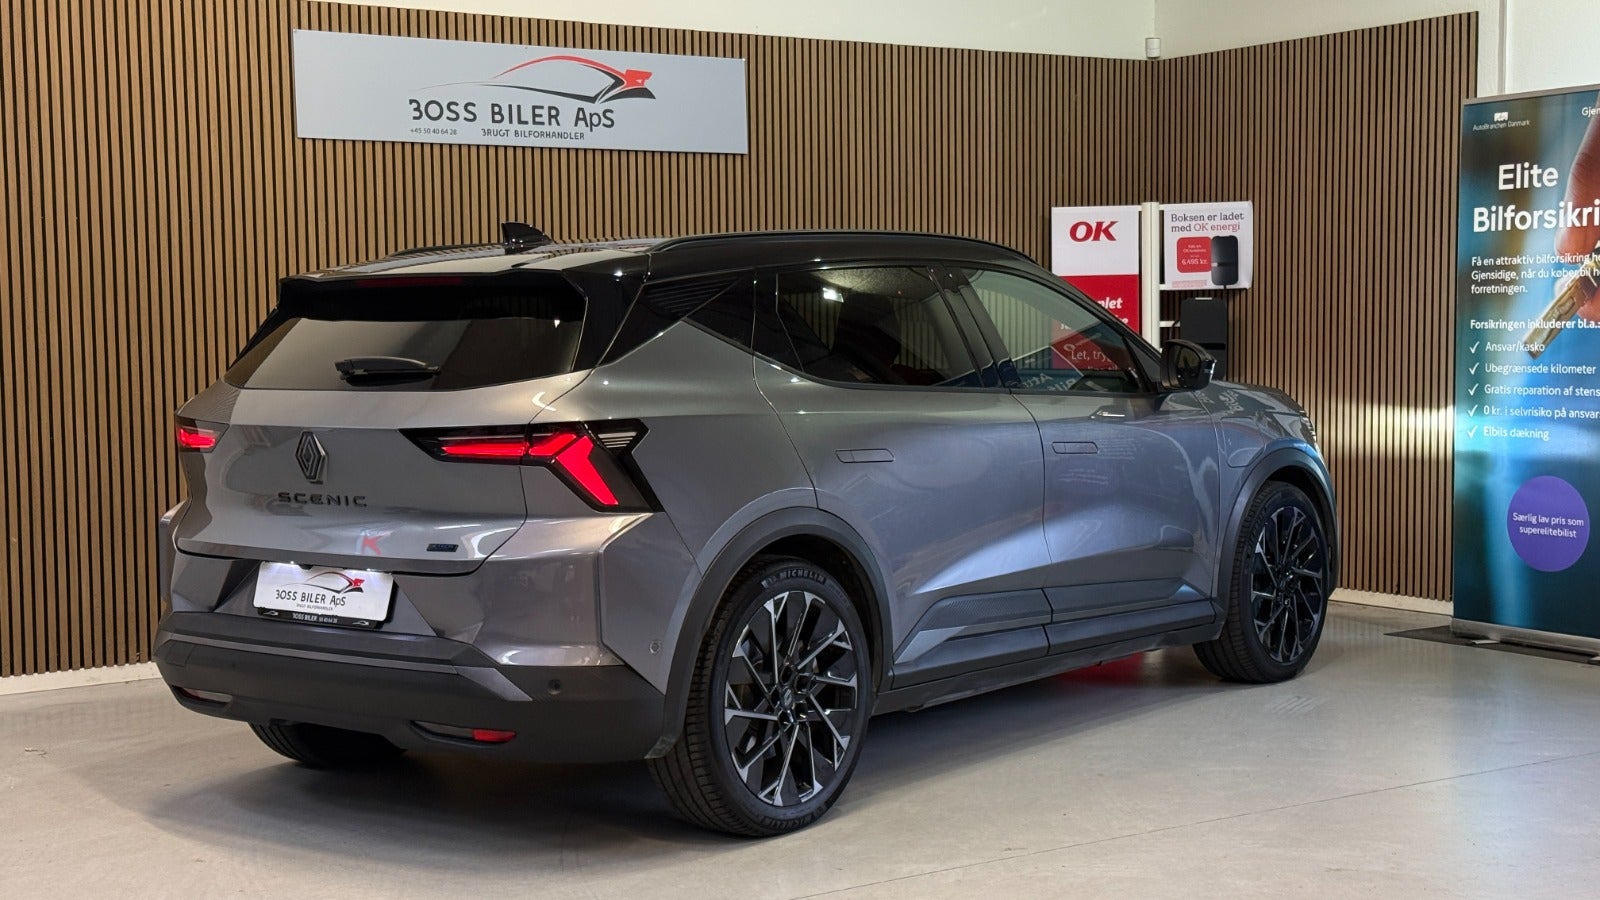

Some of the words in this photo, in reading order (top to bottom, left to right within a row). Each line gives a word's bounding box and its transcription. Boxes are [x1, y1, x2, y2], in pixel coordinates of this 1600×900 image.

[490, 103, 561, 127] BILER
[573, 107, 615, 132] ApS
[1508, 119, 1530, 128] Danmark
[514, 129, 585, 141] BILFORHANDLER
[1498, 161, 1559, 191] Elite
[1171, 213, 1205, 223] Boksen
[1220, 211, 1244, 221] ladet
[1068, 220, 1119, 243] OK
[1171, 223, 1192, 233] med
[1193, 222, 1209, 232] OK
[1211, 222, 1240, 233] energi
[1483, 257, 1494, 266] en
[1495, 254, 1534, 266] attraktiv
[1535, 252, 1590, 264] bilforsikring
[1471, 269, 1519, 282] Gjensidige,
[1521, 268, 1537, 279] når
[1538, 267, 1550, 278] du
[1471, 283, 1528, 296] forretningen.
[1470, 318, 1525, 331] Forsikringen
[1527, 318, 1576, 330] inkluderer
[1485, 341, 1546, 353] Ansvar/kasko
[1484, 363, 1549, 376] Ubegrænsede
[1551, 363, 1597, 375] kilometer
[1484, 384, 1512, 395] Gratis
[1513, 385, 1561, 398] reparation
[1563, 385, 1574, 396] af
[1509, 406, 1552, 418] selvrisiko
[1554, 407, 1567, 420] på
[1483, 426, 1508, 437] Elbils
[1509, 428, 1550, 442] dækning
[277, 491, 368, 508] SCENIC
[1512, 511, 1538, 525] Særlig
[1538, 514, 1550, 524] lav
[1551, 516, 1566, 526] pris
[1567, 518, 1585, 527] som
[1519, 525, 1577, 538] superelitebilist
[300, 592, 326, 604] BILER
[329, 595, 347, 608] ApS
